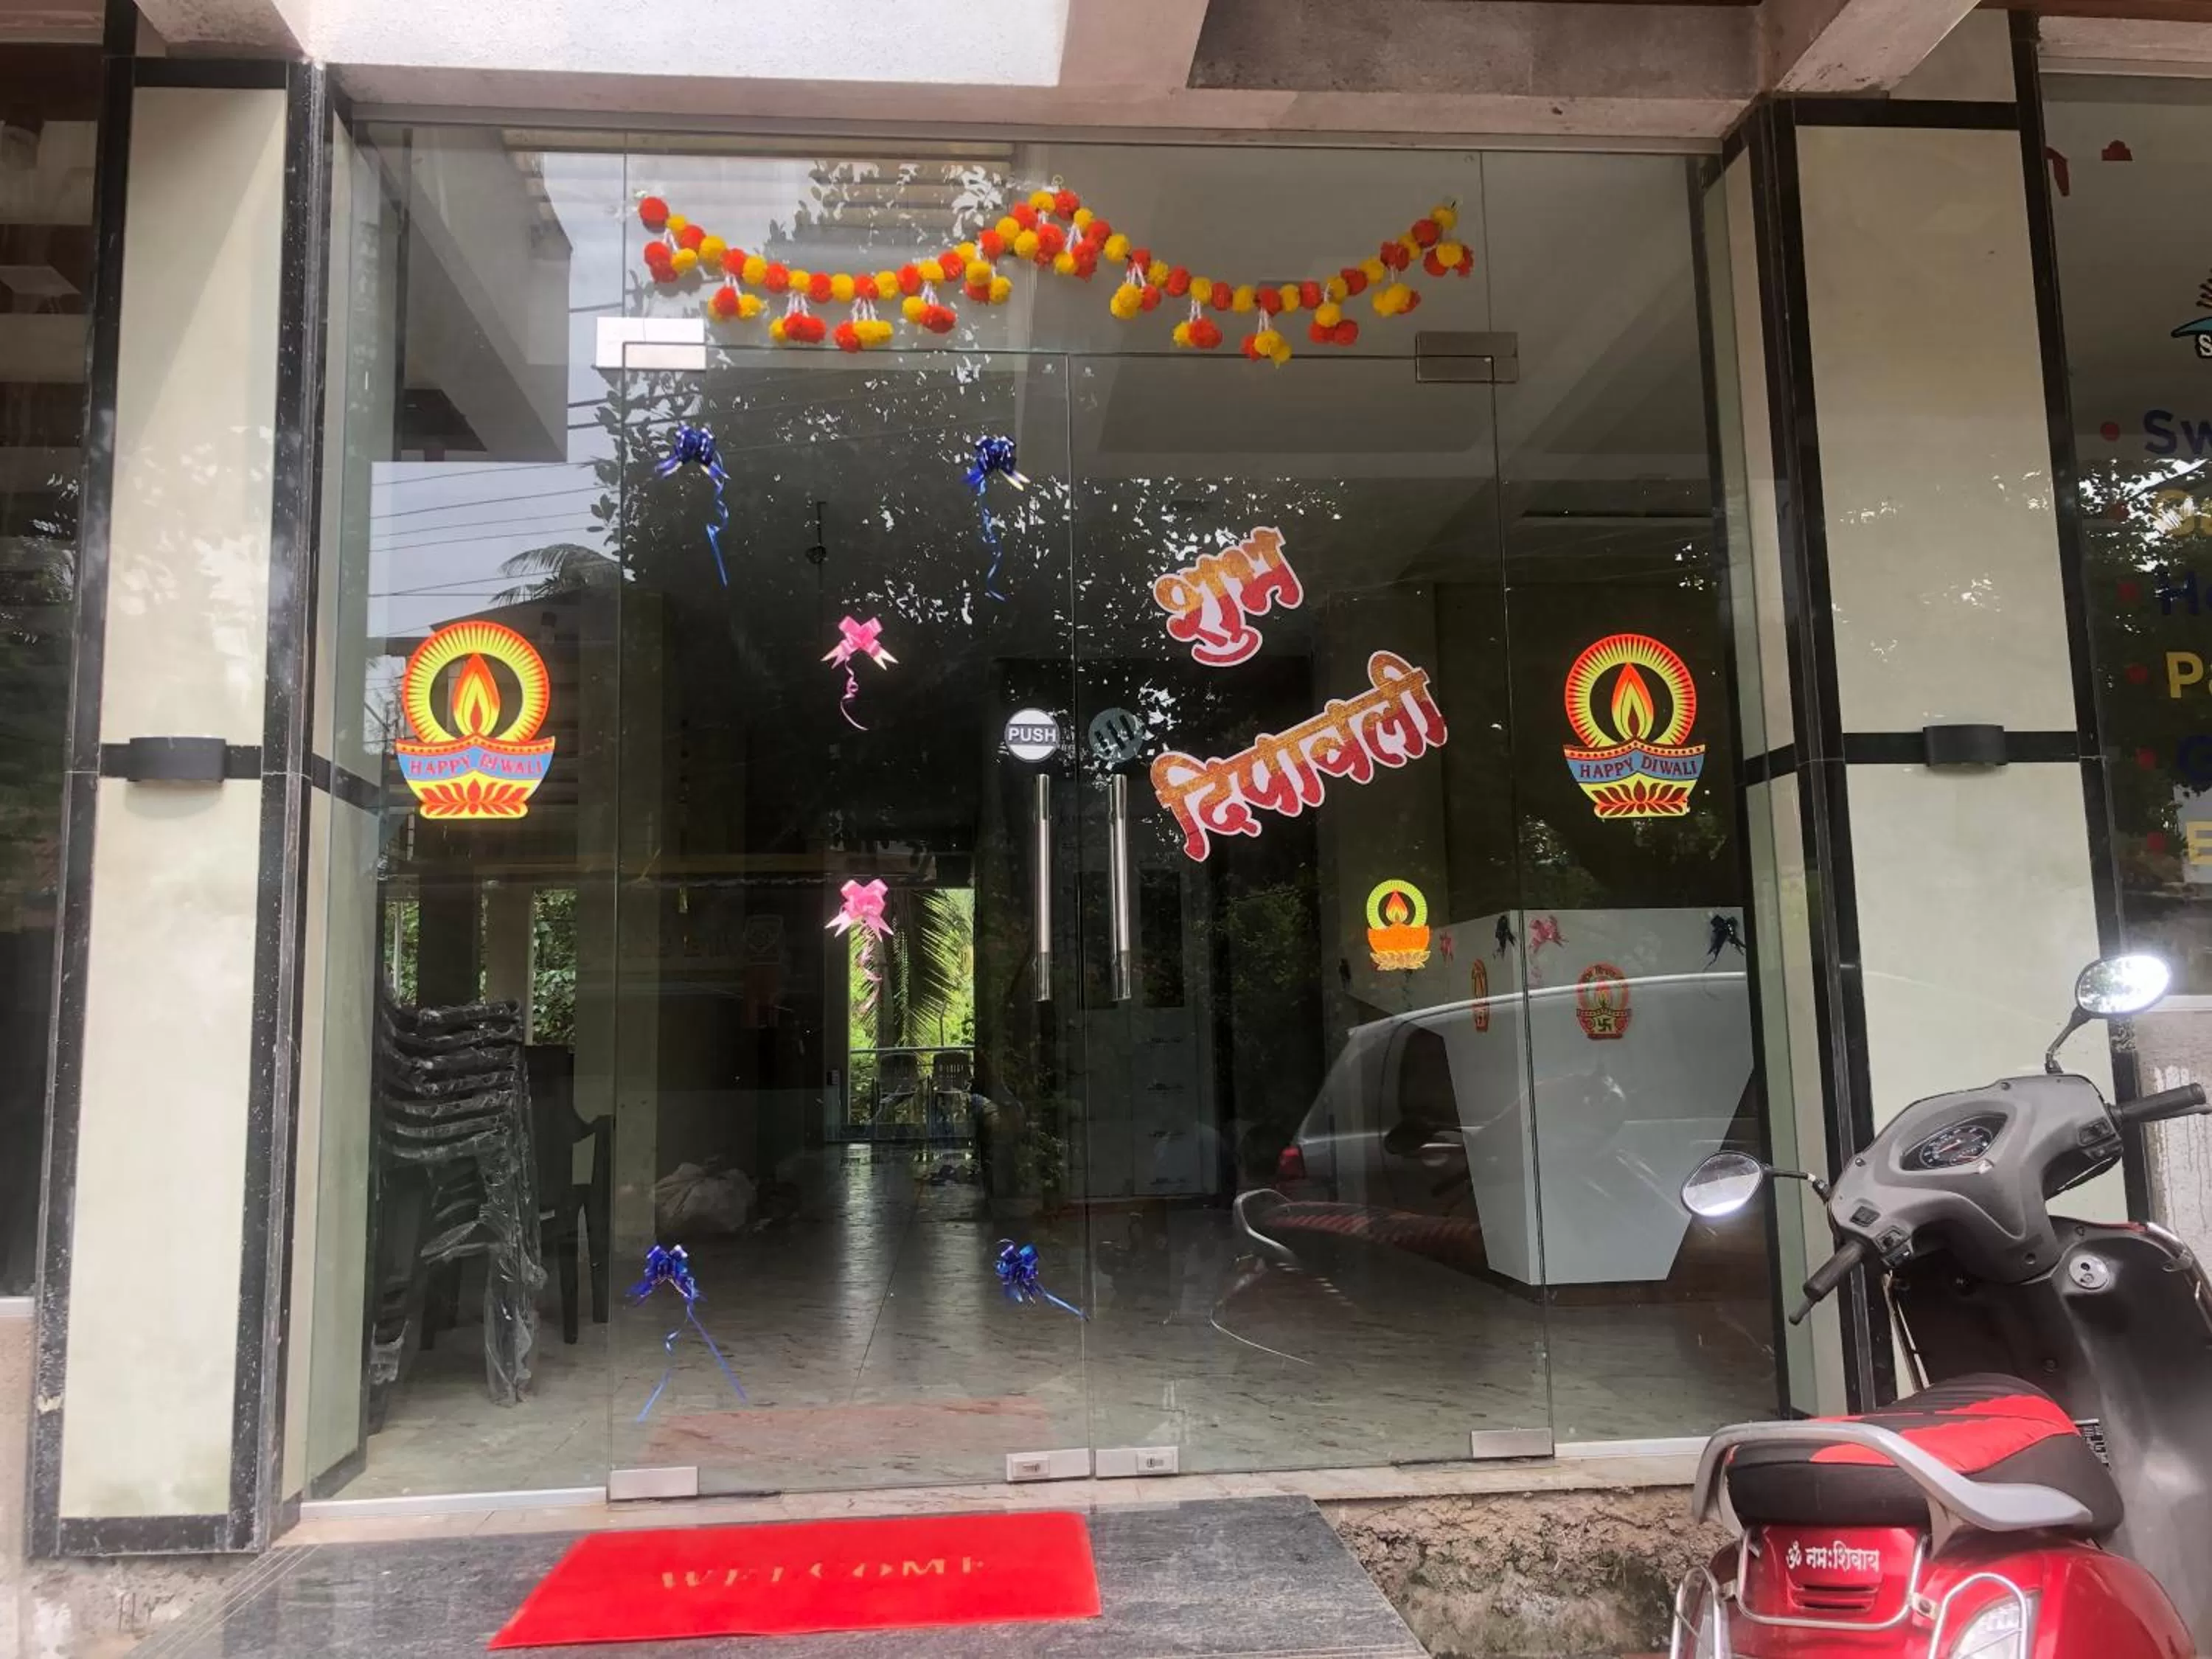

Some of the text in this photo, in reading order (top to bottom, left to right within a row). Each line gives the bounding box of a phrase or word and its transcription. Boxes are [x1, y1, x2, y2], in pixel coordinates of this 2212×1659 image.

[1153, 526, 1303, 667] शुभ
[2154, 569, 2212, 616] H
[2166, 651, 2212, 698] P
[1008, 726, 1057, 742] PUSH
[1150, 650, 1447, 861] दिपावली
[409, 754, 543, 775] HAPPY DIWALI
[1579, 756, 1698, 779] HAPPY DIWALI
